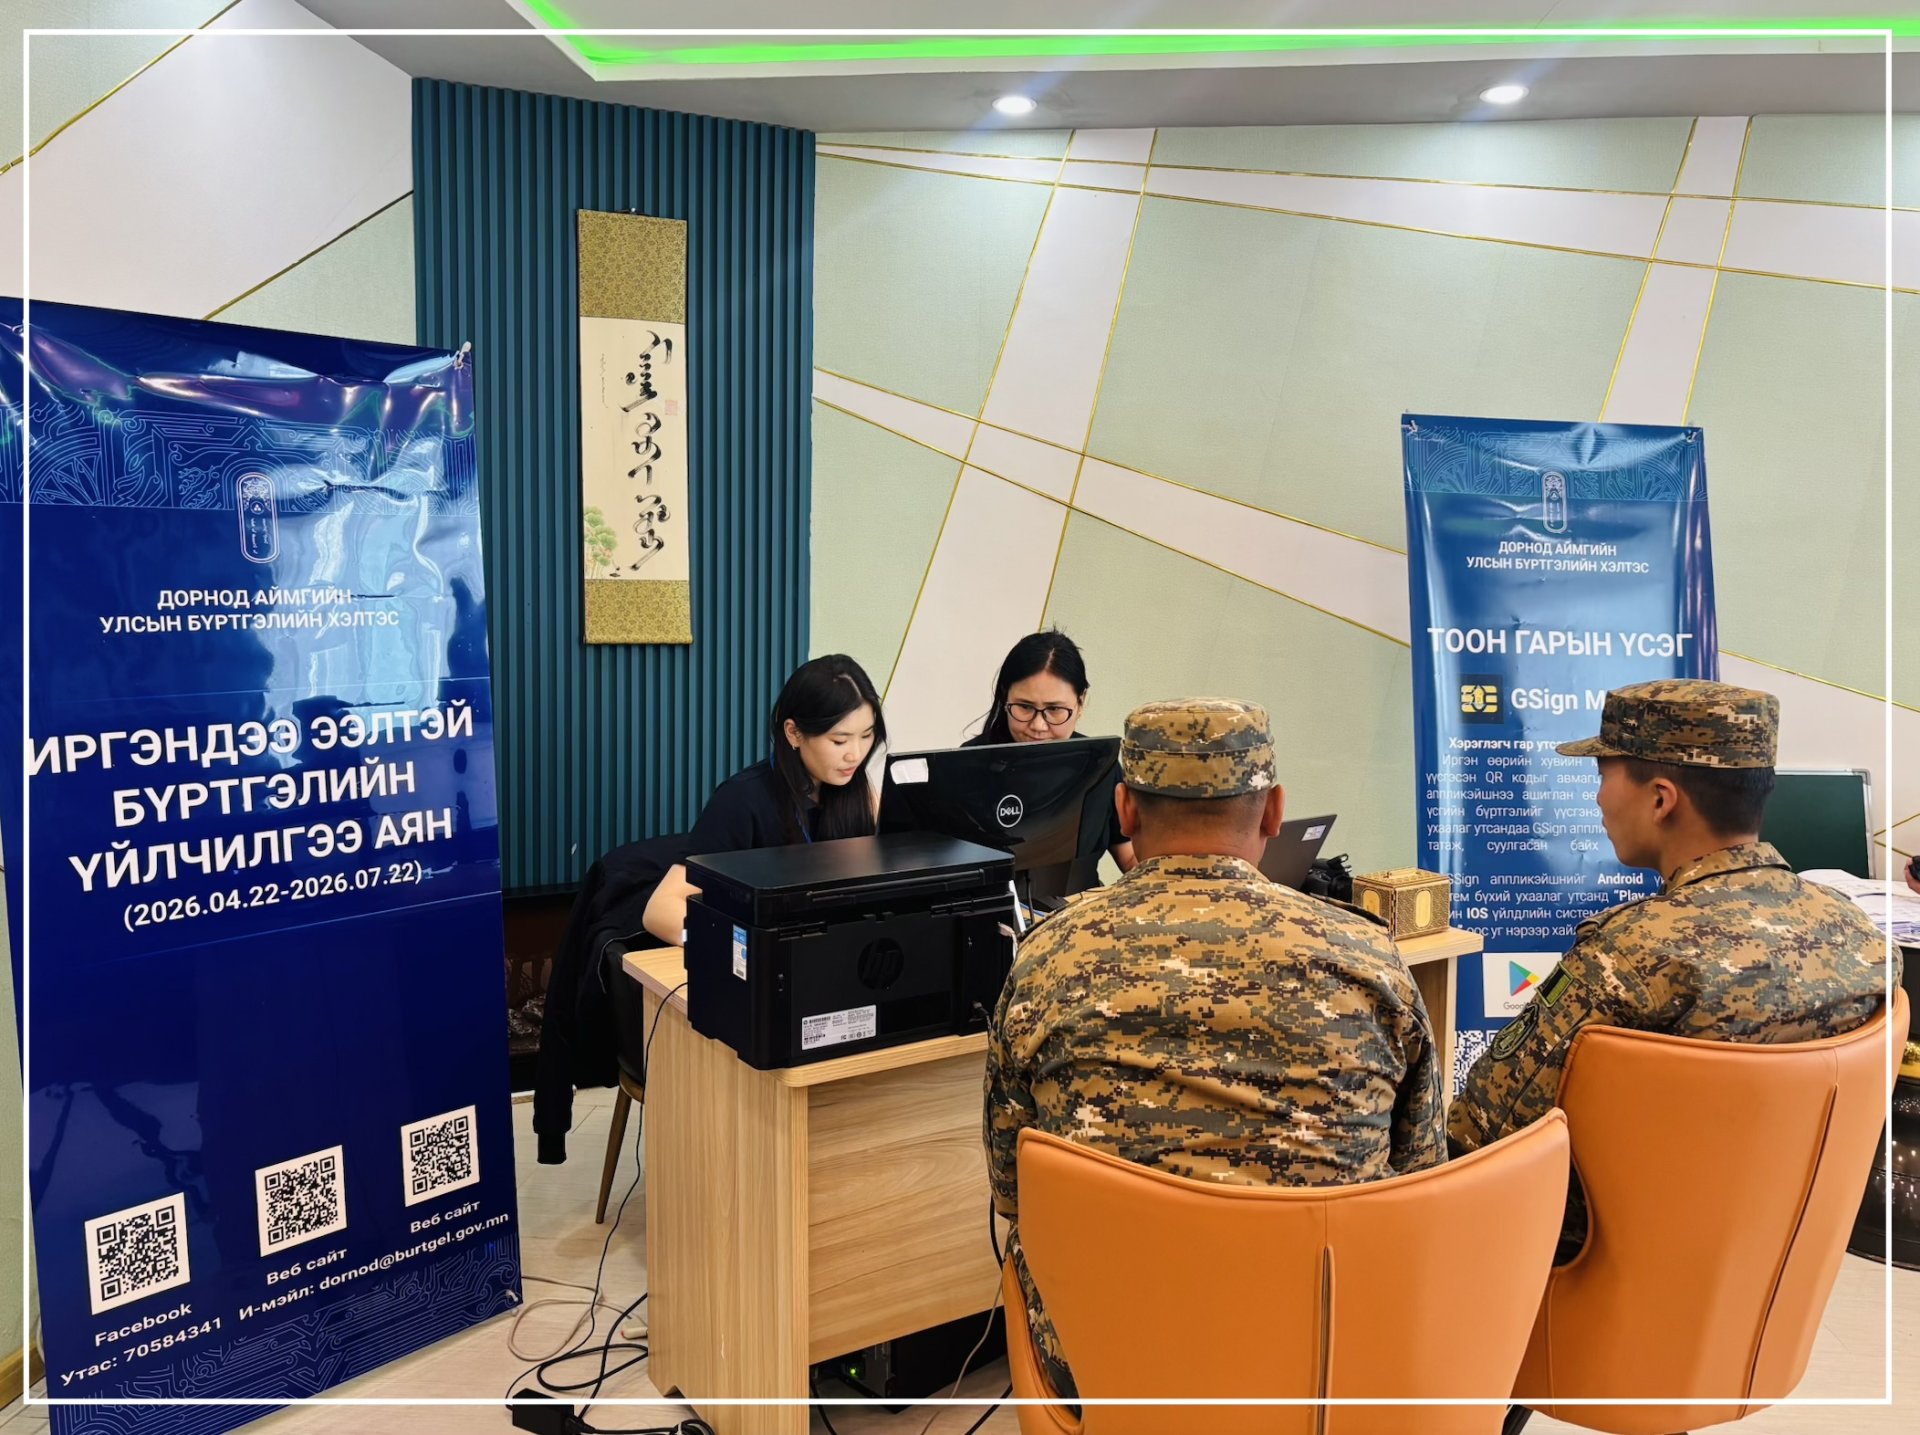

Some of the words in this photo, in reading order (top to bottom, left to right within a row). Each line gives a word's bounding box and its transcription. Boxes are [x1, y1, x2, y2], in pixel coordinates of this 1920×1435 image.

[1499, 541, 1552, 556] ДОРНОД
[1555, 542, 1617, 556] АЙМГИЙН
[1466, 556, 1512, 569] УЛСЫН
[1515, 558, 1597, 572] БҮРТГЭЛИЙН
[1600, 560, 1649, 573] ХЭЛТЭС
[157, 588, 250, 611] ДОРНОД
[254, 586, 352, 606] АЙМГИЙН
[100, 615, 182, 634] УЛСЫН
[188, 611, 323, 632] БҮРТГЭЛИЙН
[328, 610, 399, 628] ХЭЛТЭС
[1427, 627, 1505, 655] ТООН
[1515, 630, 1612, 657] ГАРЫН
[1619, 632, 1693, 658] ҮСЭГ
[1510, 688, 1578, 715] GSign
[28, 720, 298, 776] ИРГЭНДЭЭ
[311, 698, 473, 750] ЭЭЛТЭЙ
[1449, 737, 1511, 752] Хэрэглэгч
[1514, 739, 1534, 752] гар
[1442, 753, 1478, 767] Иргэн
[1487, 754, 1532, 768] өөрийн
[1485, 771, 1503, 784] QR
[1512, 773, 1547, 786] кодыг
[112, 757, 416, 829] БҮРТГЭЛИЙН
[1522, 790, 1573, 800] ашиглан
[1000, 806, 1021, 817] DELL
[1475, 805, 1544, 820] бүртгэлийг
[1474, 824, 1530, 836] утсандаа
[1532, 821, 1567, 836] GSign
[68, 820, 363, 893] ҮЙЛЧИЛГЭЭ
[375, 808, 453, 850] АЯН
[1487, 840, 1548, 853] суулгасан
[1570, 838, 1599, 851] байх
[1490, 873, 1587, 885] аппликэйшнийг
[1597, 872, 1644, 885] Android
[123, 859, 423, 933] (2026.04.22-2026.07.22)
[1474, 889, 1511, 904] бүхий
[1515, 892, 1563, 904] ухаалаг
[1567, 892, 1610, 904] утсанд
[1466, 907, 1489, 919] IOS
[1492, 907, 1551, 921] үйлдлийн
[1506, 927, 1550, 939] нэрээр
[410, 1213, 442, 1234] Веб
[444, 1201, 481, 1224] сайт
[239, 1286, 316, 1322] И-мэйл:
[319, 1212, 510, 1292] dornod@burtgel.gov.mn
[266, 1265, 302, 1286] Веб
[304, 1248, 348, 1277] сайт
[94, 1302, 193, 1347] Facebook
[61, 1356, 118, 1386] Утас:
[124, 1317, 222, 1363] 70584341
